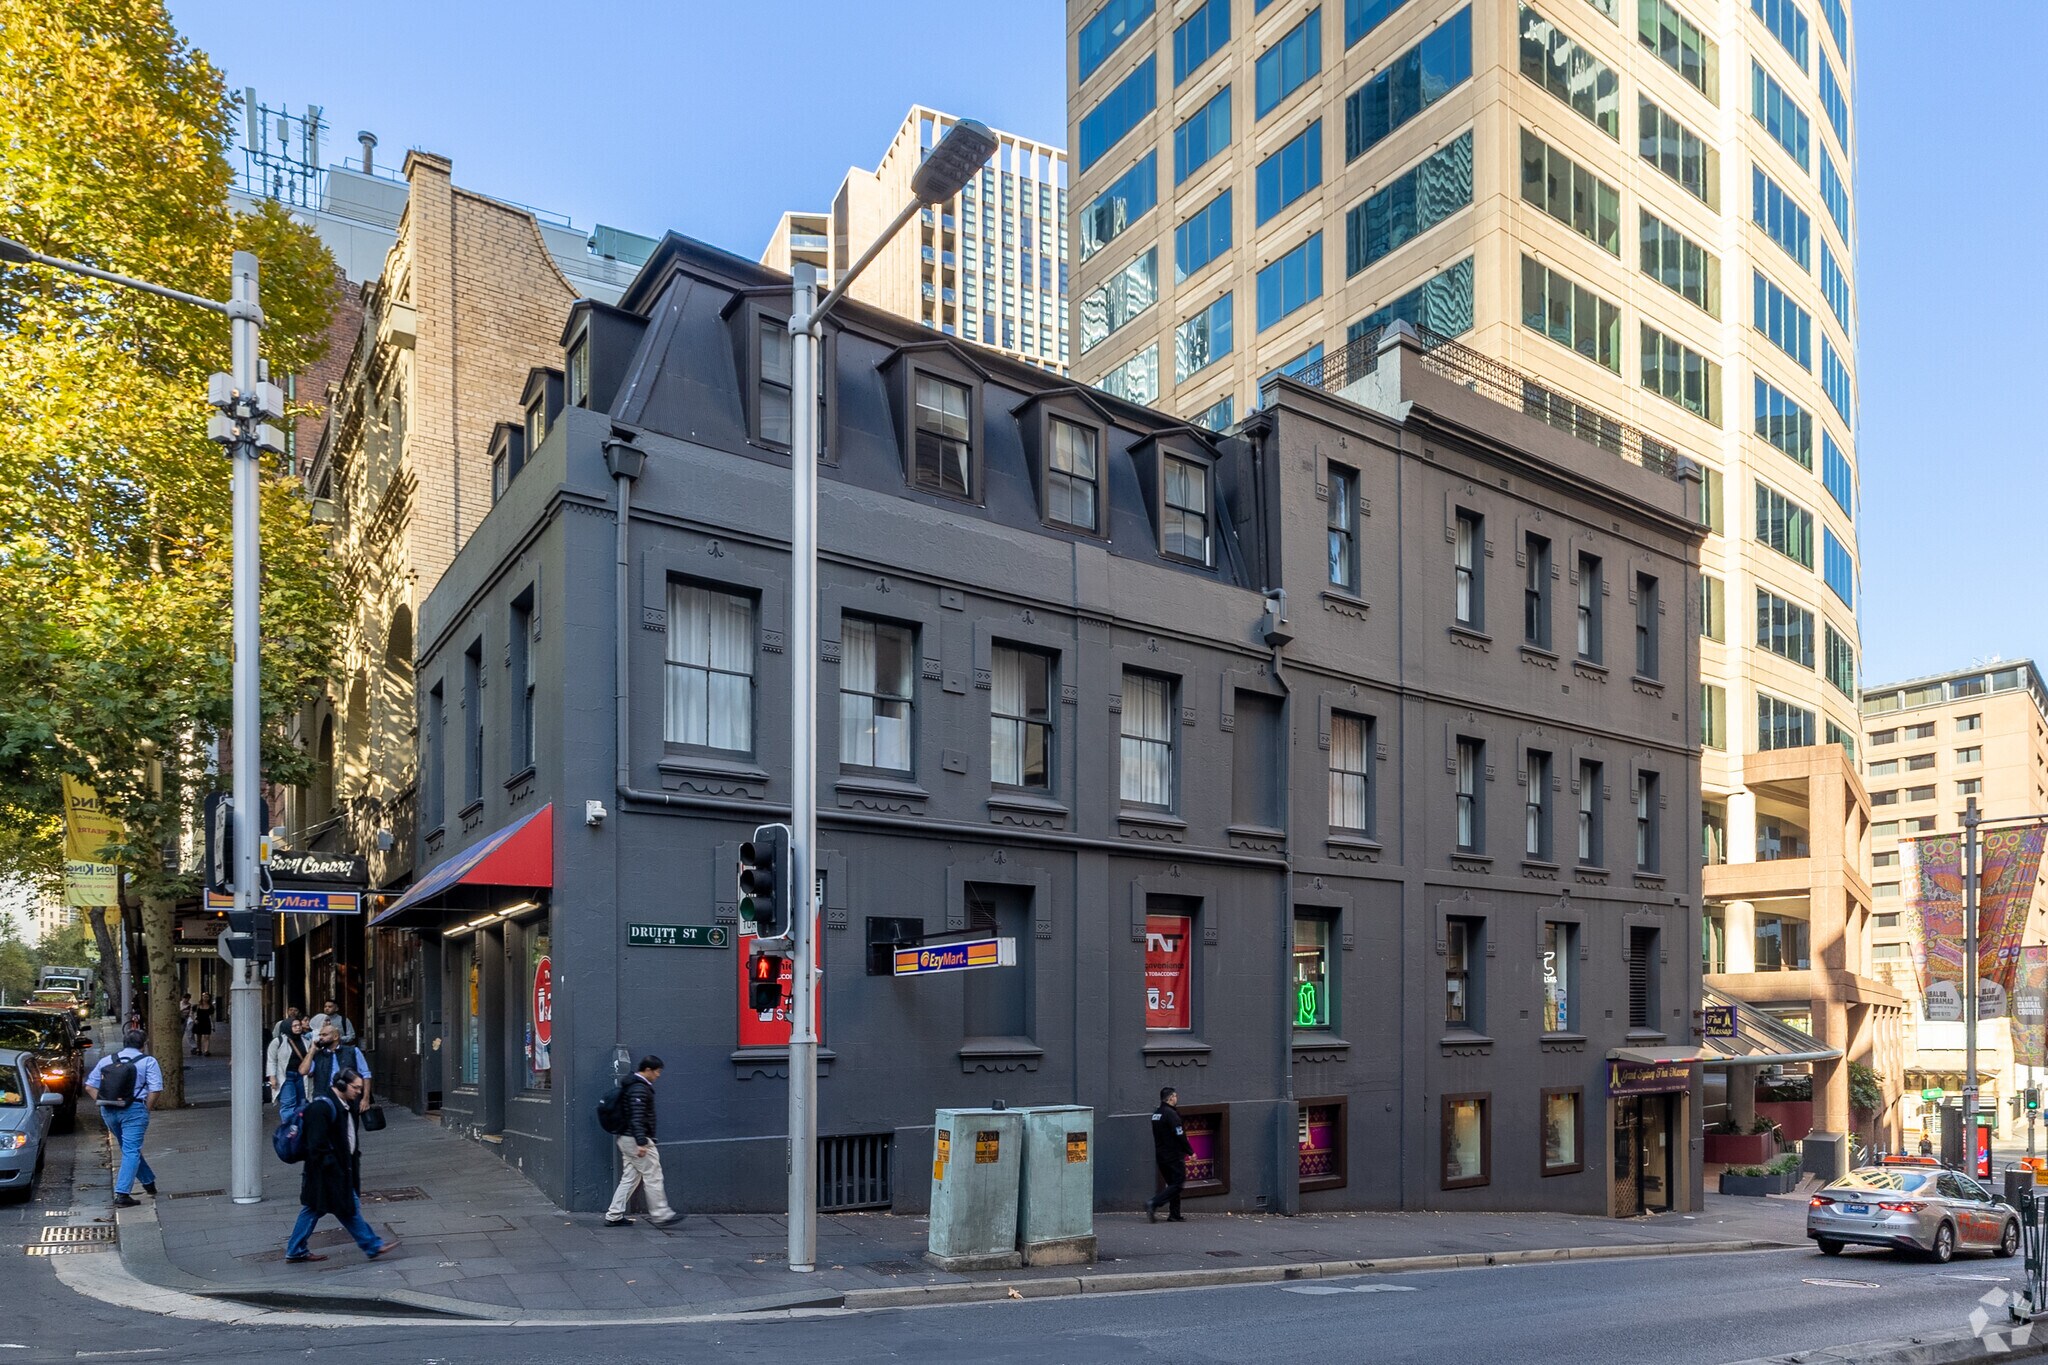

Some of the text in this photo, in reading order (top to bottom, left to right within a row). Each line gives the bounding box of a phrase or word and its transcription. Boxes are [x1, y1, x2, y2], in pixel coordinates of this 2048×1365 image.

[269, 855, 354, 877] cary Canary
[631, 926, 698, 939] DRUITT ST
[1145, 933, 1184, 952] TNT
[929, 951, 964, 970] EzyMart
[1160, 991, 1175, 1009] $2
